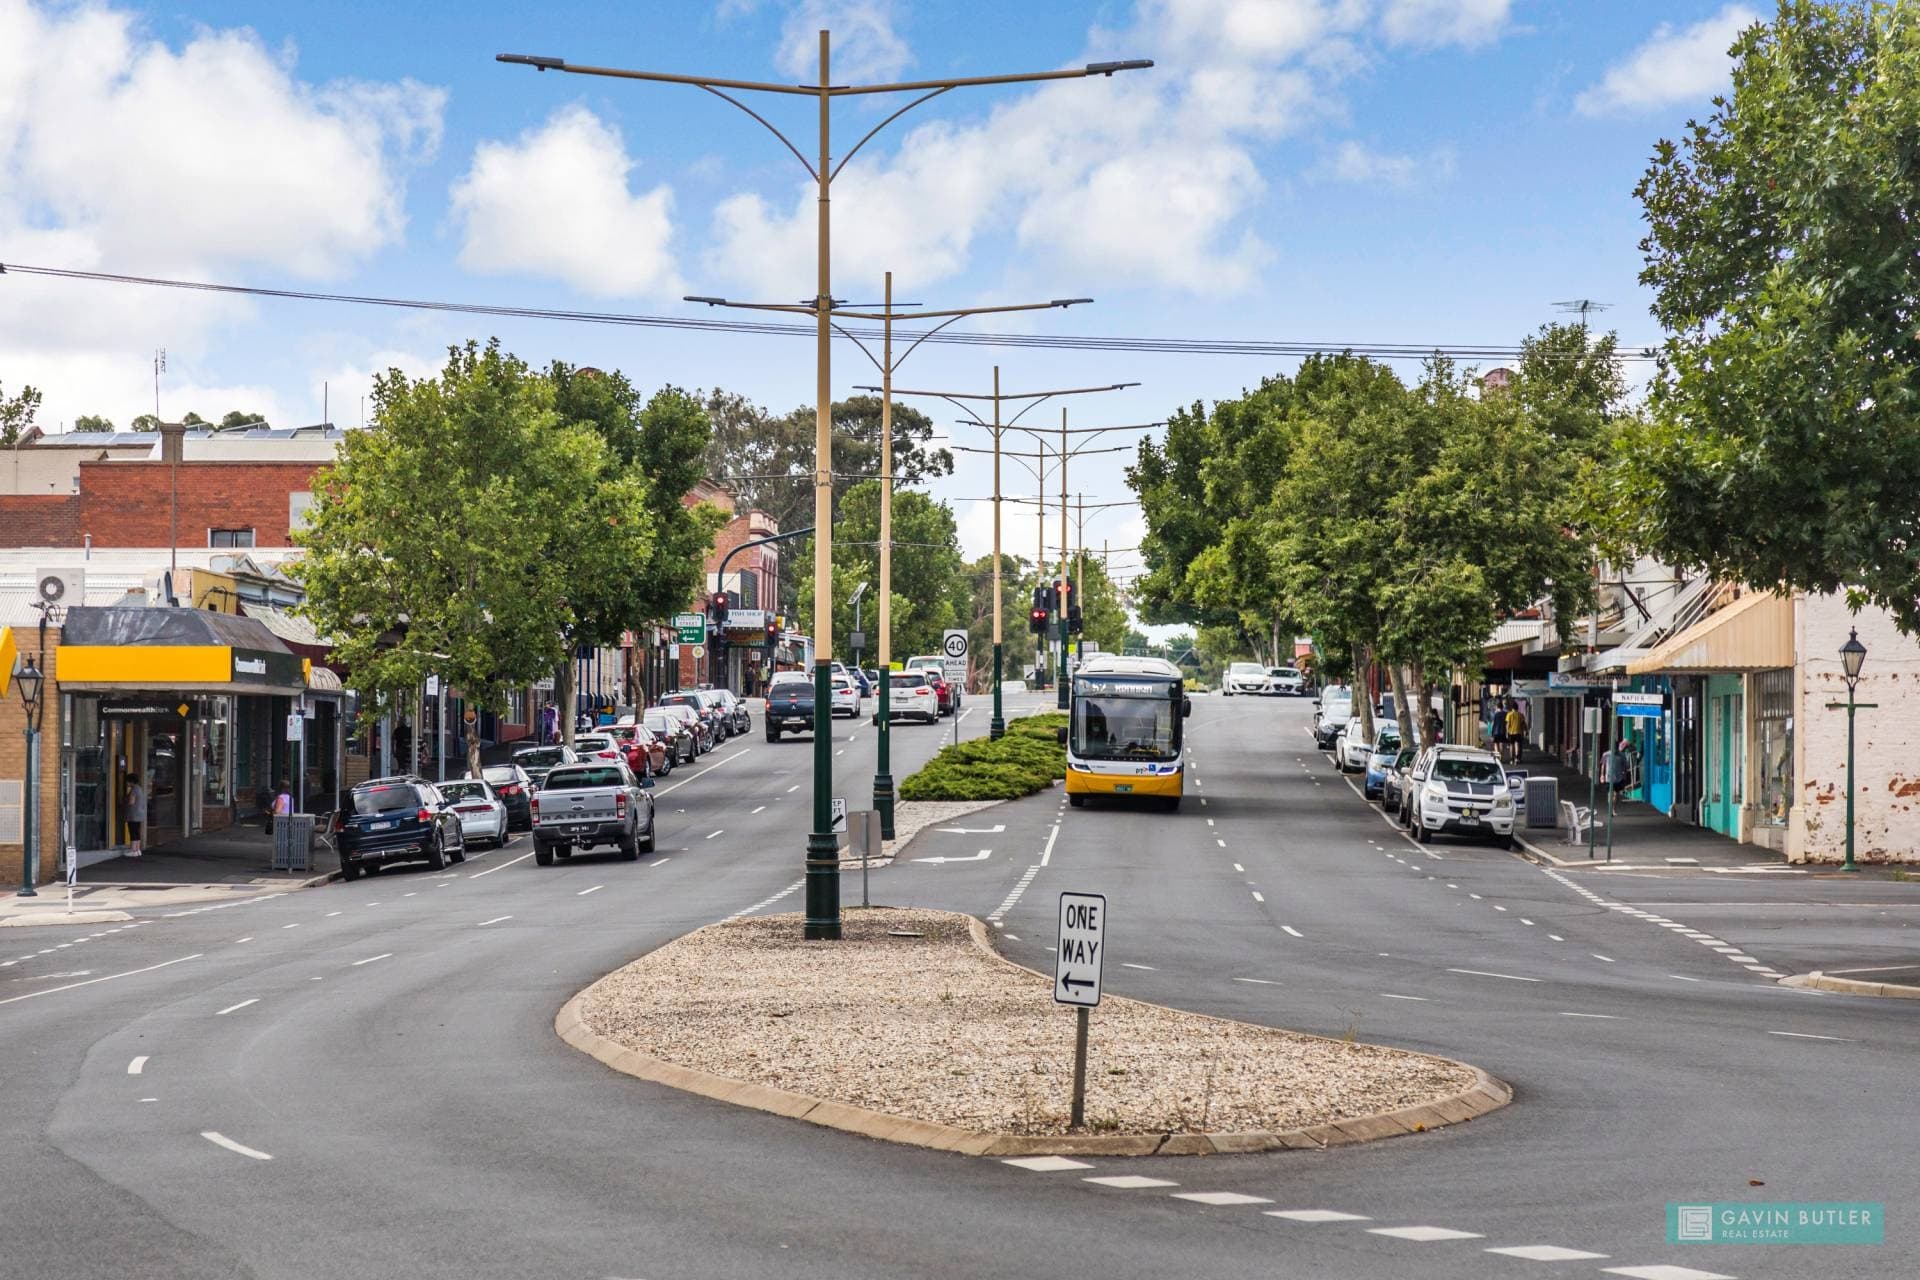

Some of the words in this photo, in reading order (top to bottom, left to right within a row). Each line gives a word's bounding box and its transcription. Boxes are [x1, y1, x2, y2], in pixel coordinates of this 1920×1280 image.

[948, 640, 964, 651] 40
[1066, 904, 1097, 930] ONE
[1063, 938, 1098, 965] WAY
